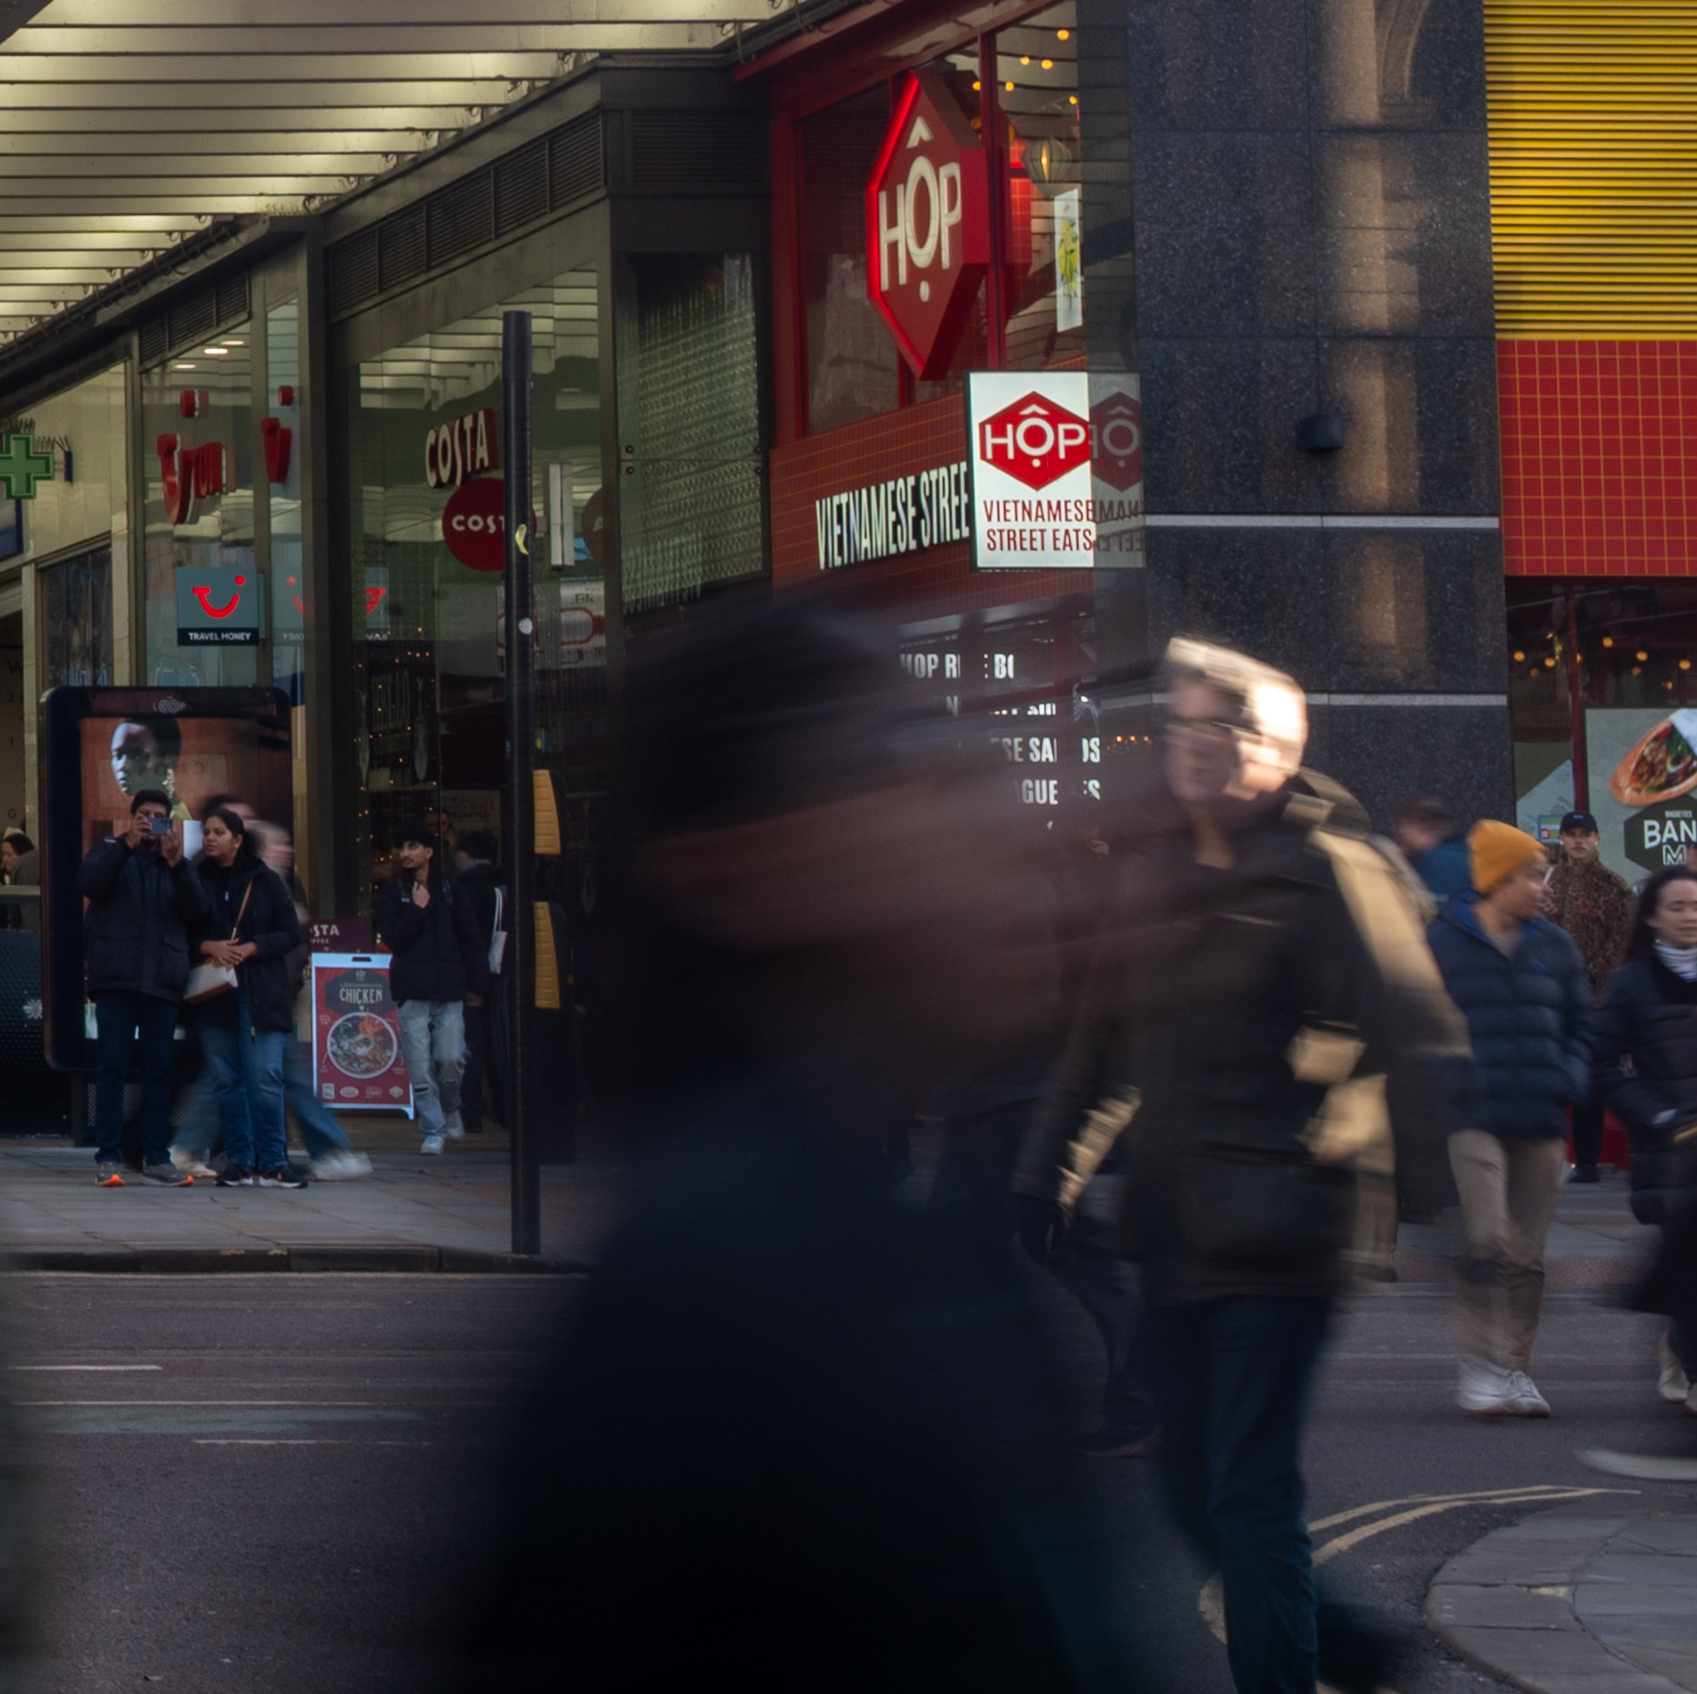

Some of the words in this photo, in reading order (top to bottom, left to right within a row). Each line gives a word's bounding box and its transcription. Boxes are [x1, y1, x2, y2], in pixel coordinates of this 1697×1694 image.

[425, 408, 489, 488] COSTA
[816, 476, 917, 571] VIETNAMESE
[919, 462, 970, 541] STREE
[983, 500, 1094, 523] VIETNAMESE
[452, 513, 505, 535] COS
[986, 528, 1046, 552] STREET
[1054, 528, 1094, 552] EATS
[188, 631, 221, 642] TRAVEL
[222, 631, 252, 642] MONEY
[1662, 844, 1687, 866] M
[310, 924, 340, 938] STA
[339, 987, 384, 1005] CHICKEN
